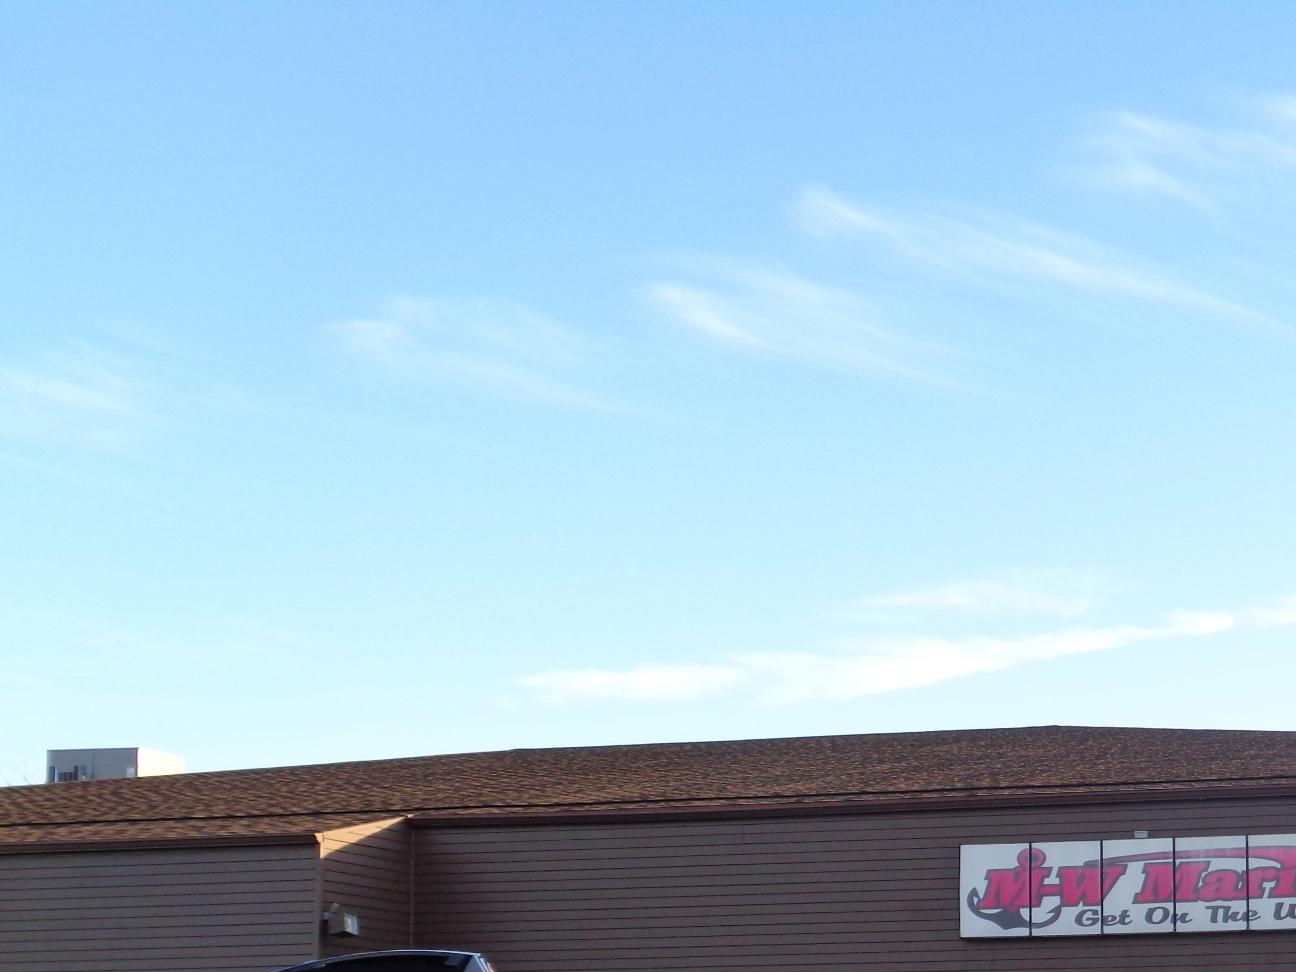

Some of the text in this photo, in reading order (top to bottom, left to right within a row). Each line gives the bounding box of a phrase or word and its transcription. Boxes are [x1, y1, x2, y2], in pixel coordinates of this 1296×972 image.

[1074, 908, 1133, 928] Get
[1144, 906, 1192, 925] On
[1204, 904, 1262, 924] The
